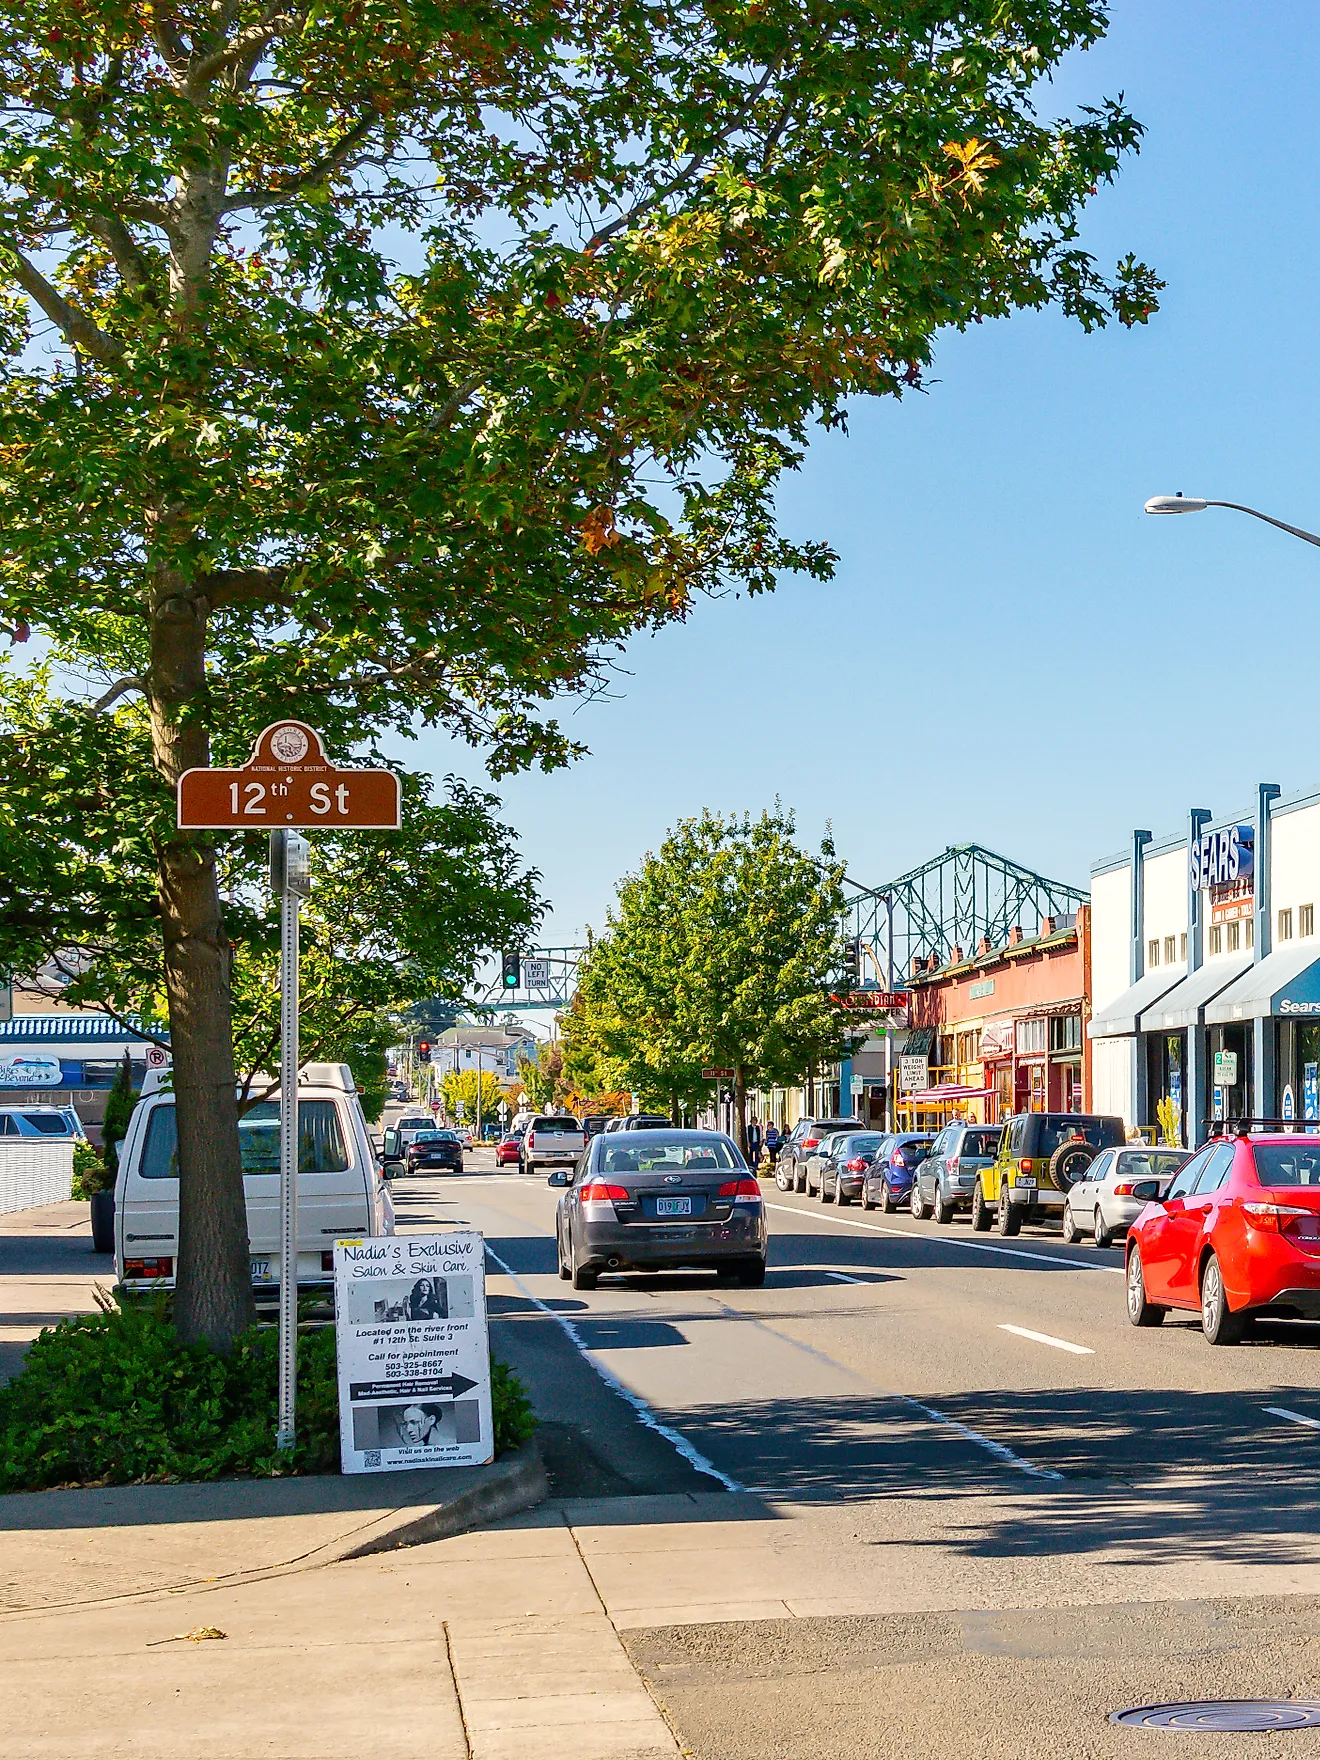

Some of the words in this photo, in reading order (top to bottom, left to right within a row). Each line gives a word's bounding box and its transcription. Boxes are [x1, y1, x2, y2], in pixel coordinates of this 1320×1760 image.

[229, 782, 288, 814] 12th
[309, 782, 350, 815] St
[1191, 826, 1239, 892] SEARS
[344, 1244, 401, 1261] Nadia's
[408, 1240, 474, 1257] Exclusive
[352, 1265, 387, 1278] Salon
[392, 1263, 406, 1275] &
[410, 1262, 437, 1274] Skin
[356, 1327, 392, 1337] Located
[407, 1326, 422, 1334] the
[447, 1323, 468, 1331] front
[373, 1337, 384, 1345] #1
[368, 1353, 385, 1361] Call
[387, 1352, 400, 1360] for
[403, 1349, 459, 1359] appointment
[385, 1360, 443, 1370] 503-325-8667
[386, 1368, 443, 1378] 503-338-8104
